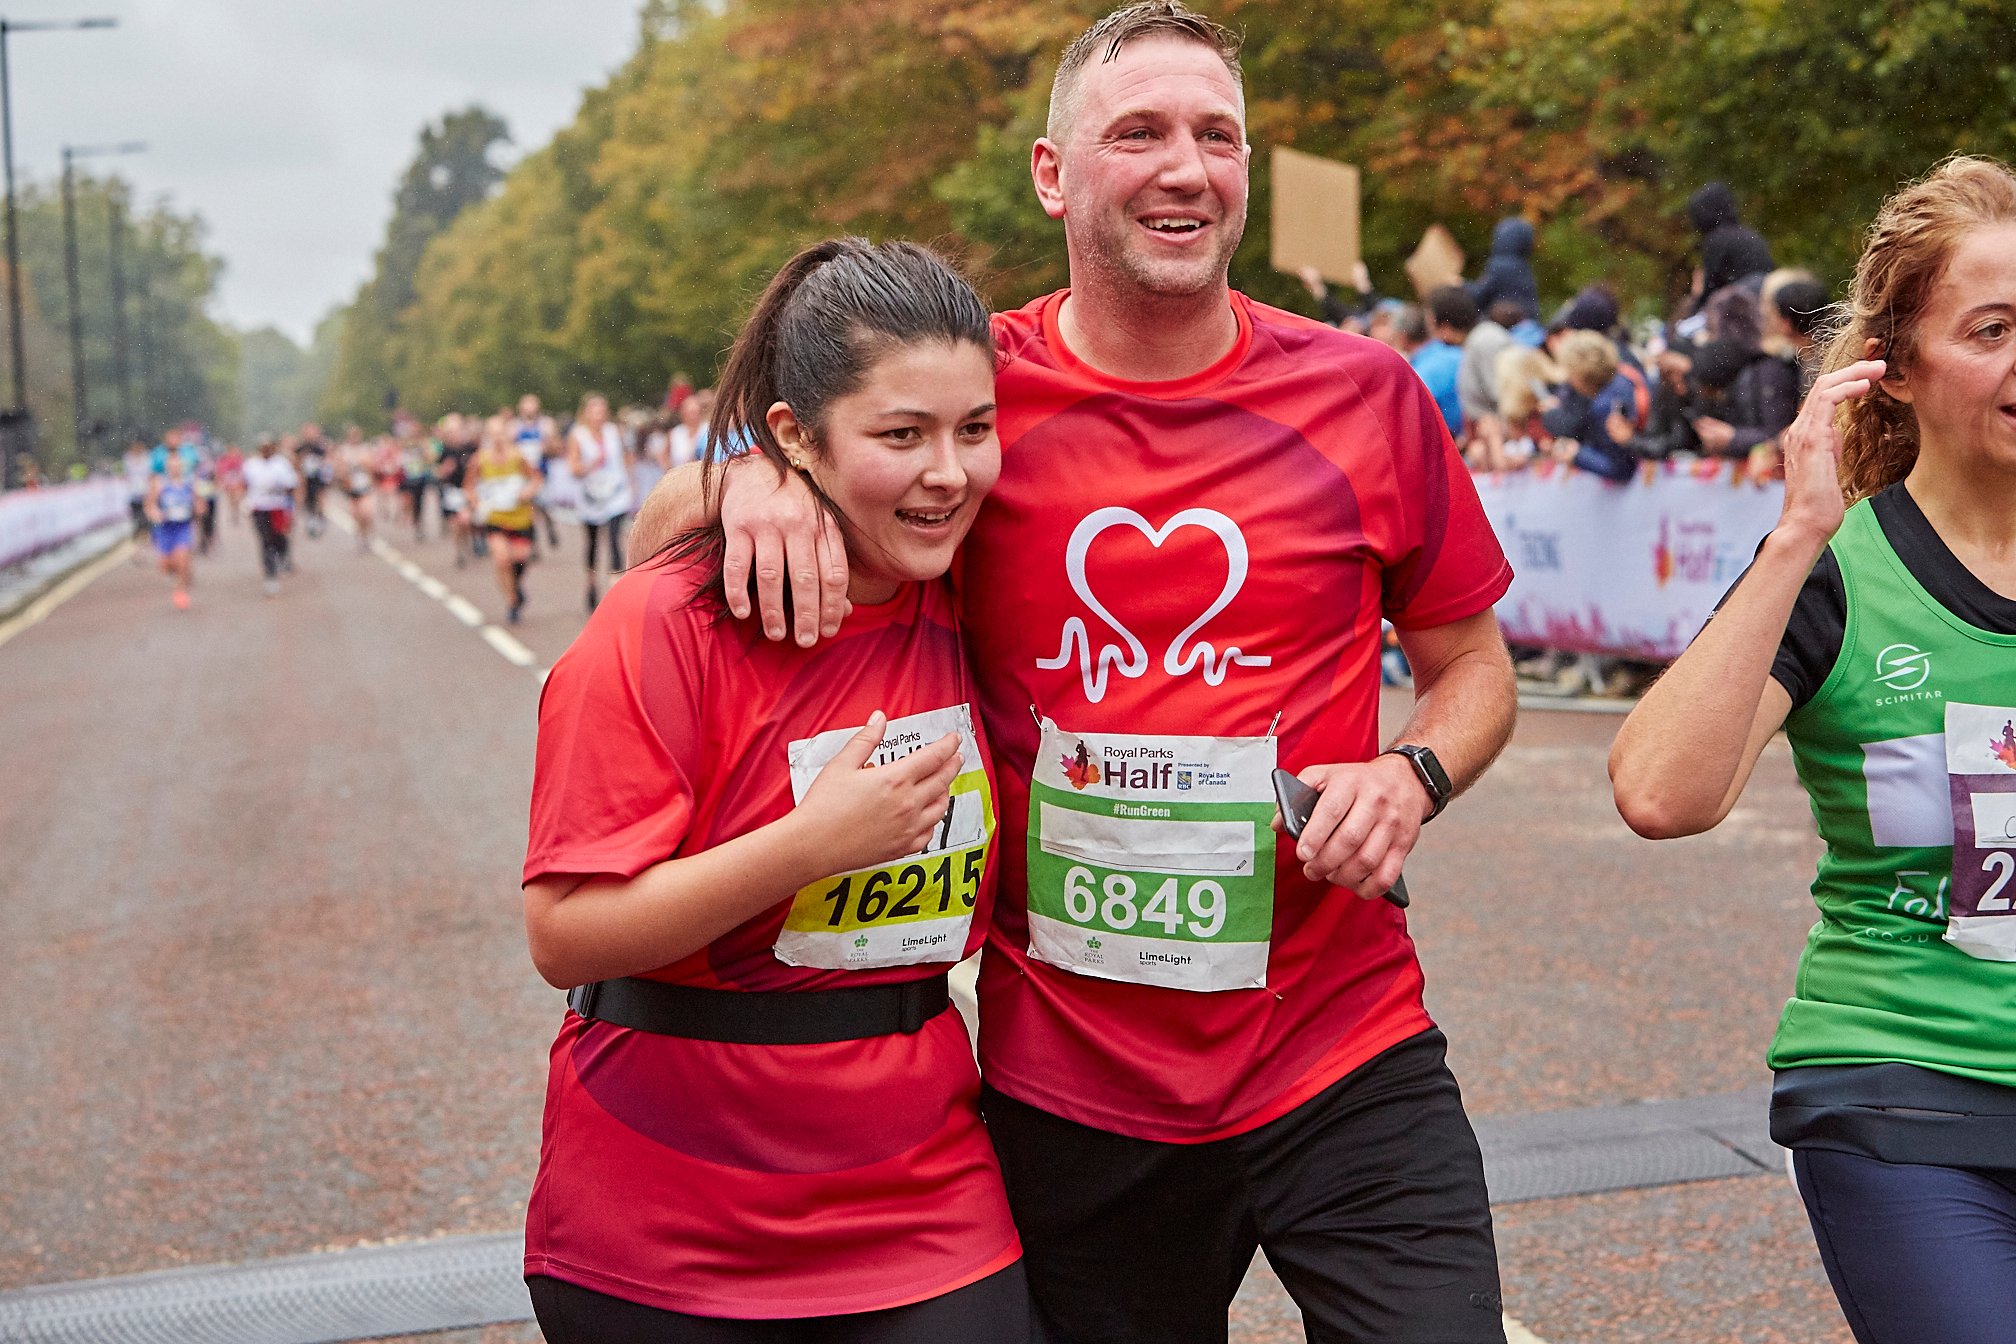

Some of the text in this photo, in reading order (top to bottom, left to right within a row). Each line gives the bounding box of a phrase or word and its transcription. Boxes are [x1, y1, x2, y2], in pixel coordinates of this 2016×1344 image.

[1875, 690, 1943, 707] SCIMITAR
[879, 735, 899, 750] Royal
[899, 731, 921, 745] Parks
[1104, 746, 1174, 759] Royal Parks
[1103, 760, 1173, 790] Half
[1198, 772, 1215, 781] Royal
[1205, 778, 1227, 786] Canada
[1113, 803, 1171, 818] #RunGreen
[824, 848, 985, 927] 16215
[1976, 851, 2016, 912] 2
[1063, 866, 1227, 938] 6849
[902, 933, 947, 946] LimeLight
[1139, 951, 1192, 966] LimeLight
